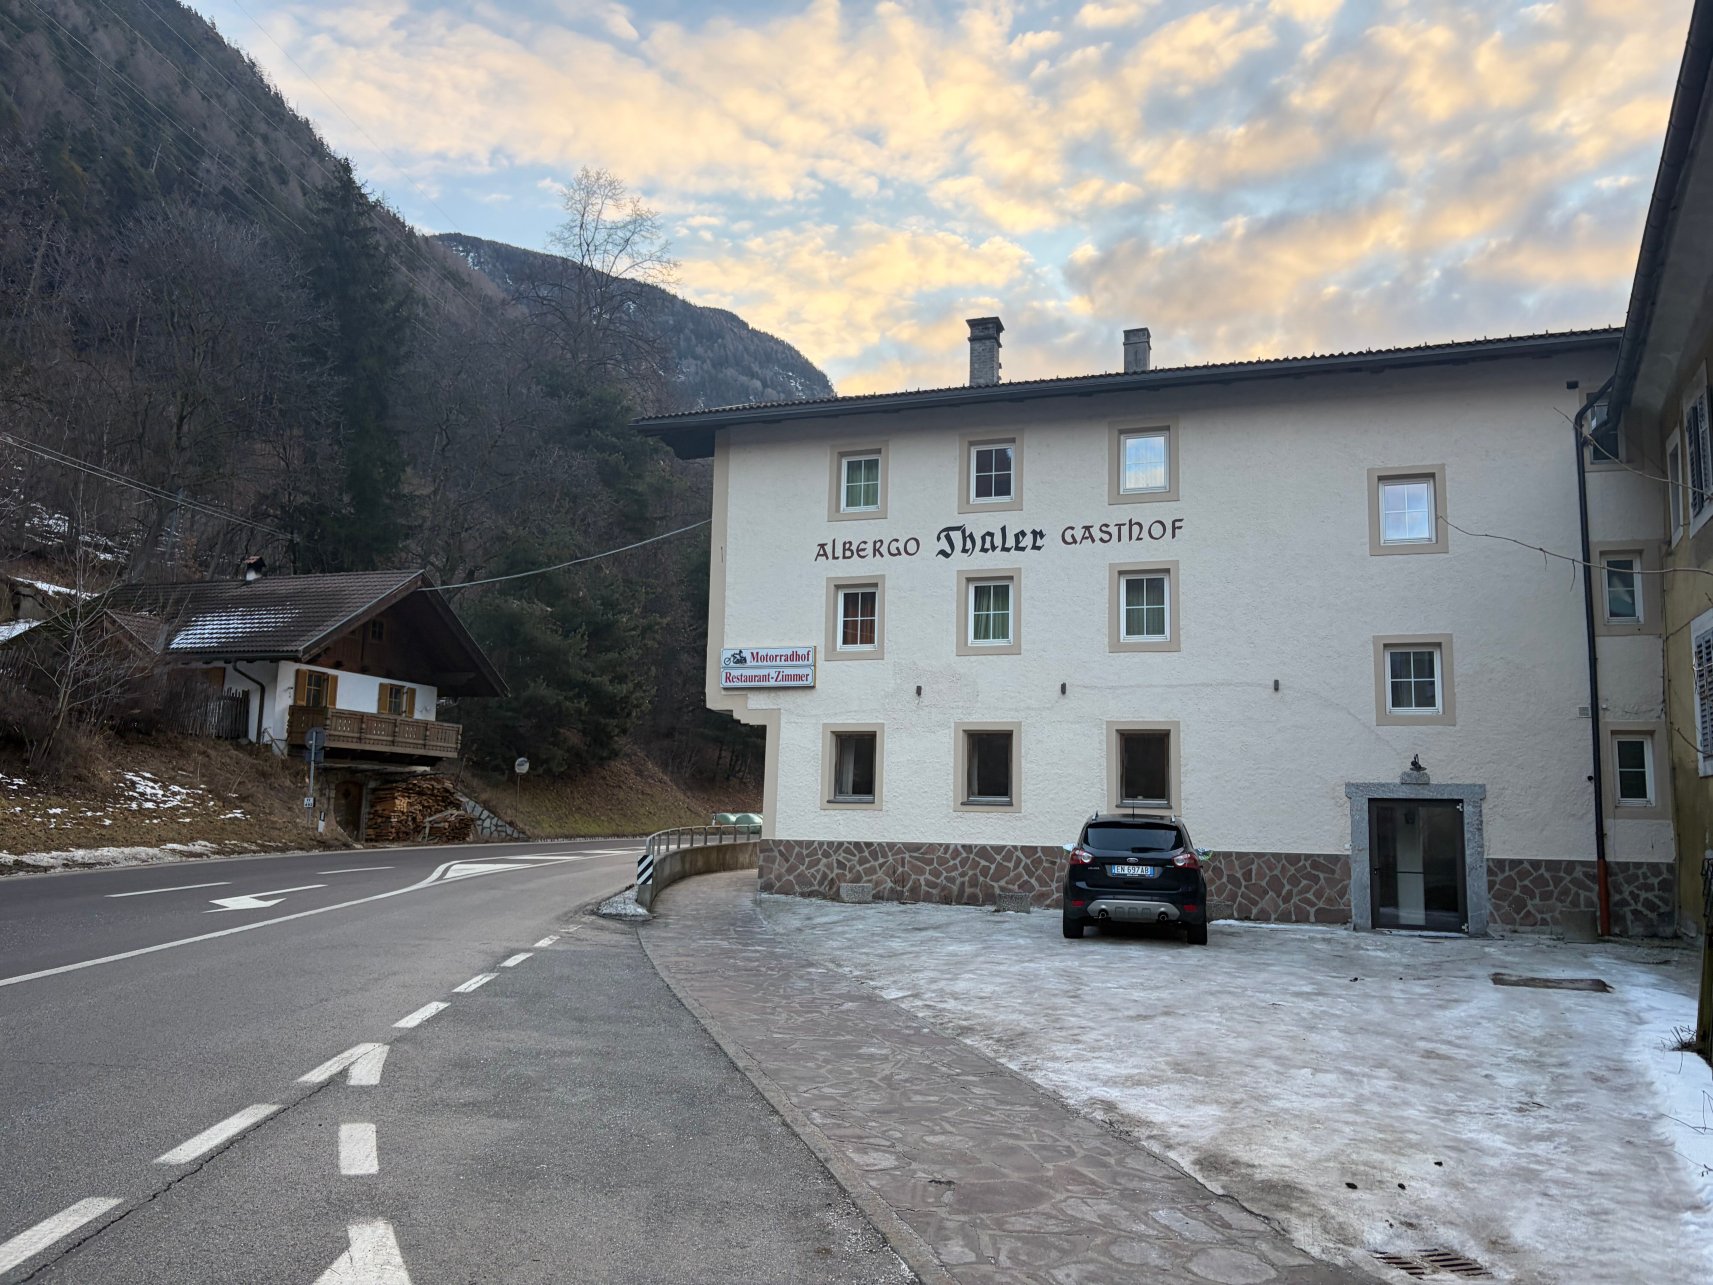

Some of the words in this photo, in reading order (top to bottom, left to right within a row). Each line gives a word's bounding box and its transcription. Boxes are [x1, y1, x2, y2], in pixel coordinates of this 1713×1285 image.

[814, 537, 921, 561] ALBERGO
[935, 523, 1047, 559] Thaler
[750, 649, 811, 663] Motorradhof
[724, 670, 810, 684] Restaurant-Zimmer
